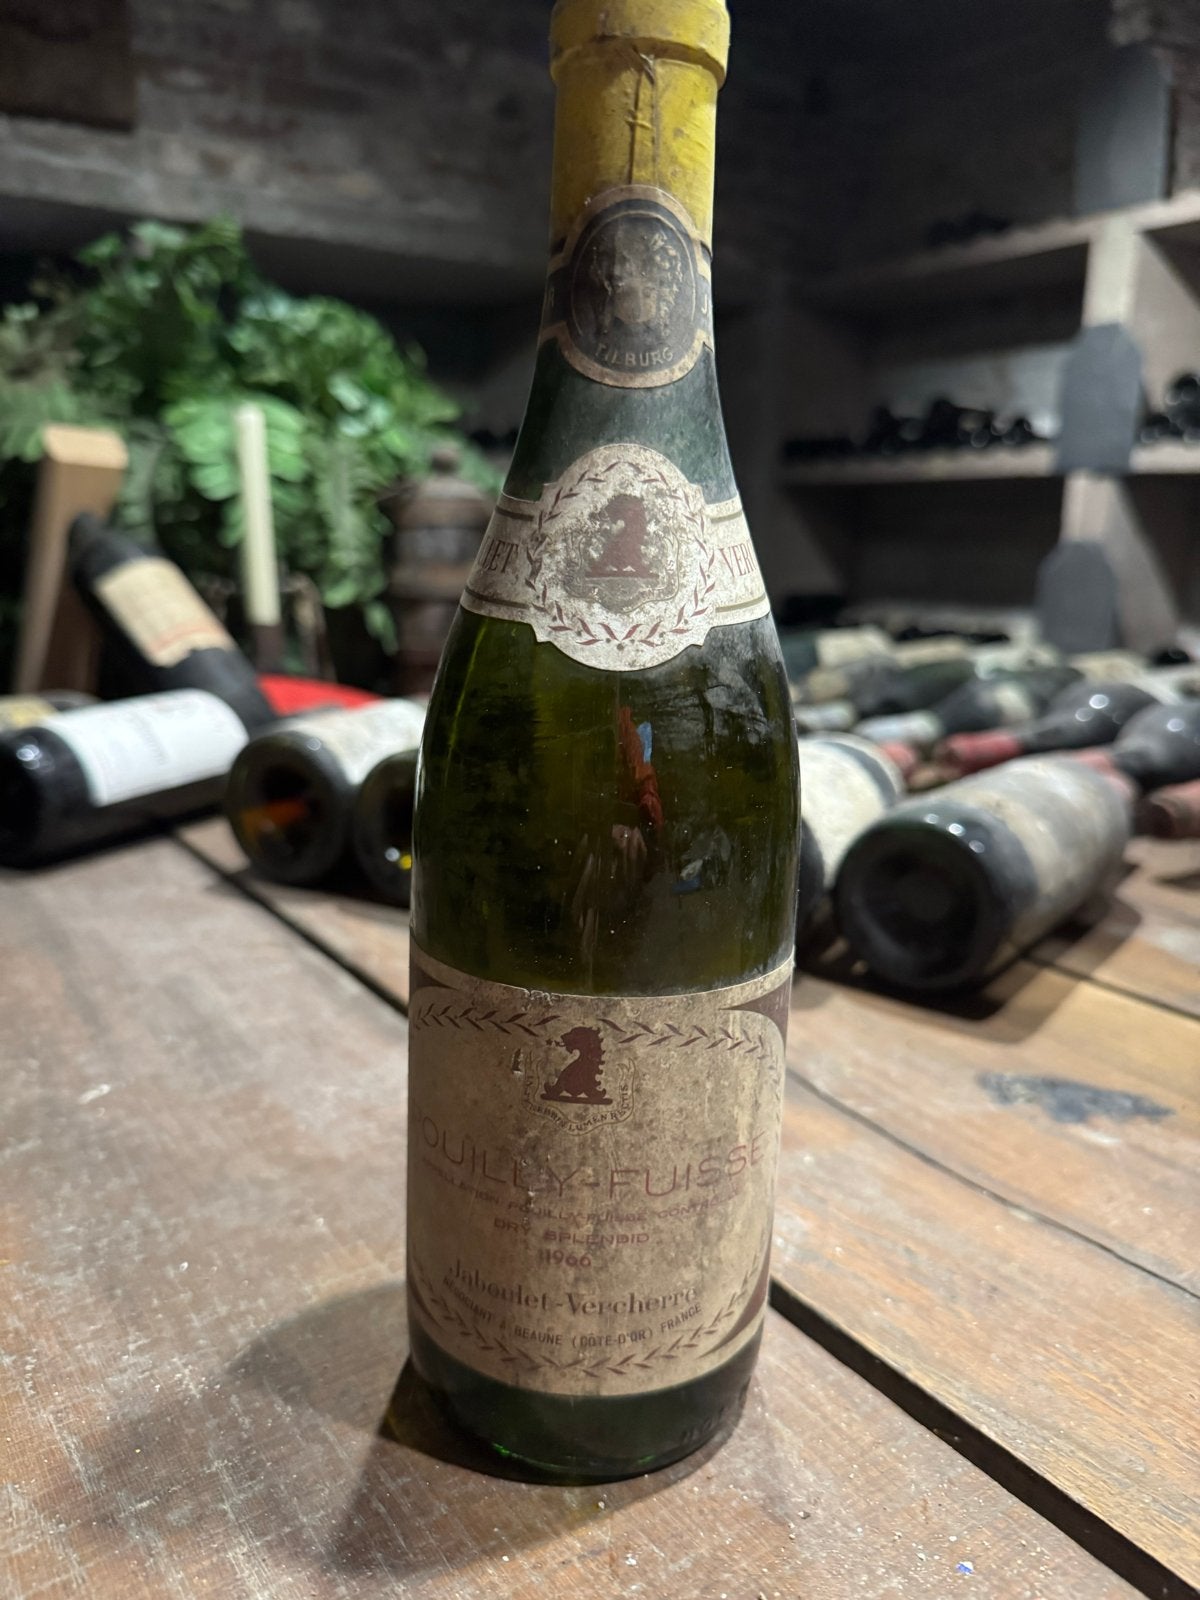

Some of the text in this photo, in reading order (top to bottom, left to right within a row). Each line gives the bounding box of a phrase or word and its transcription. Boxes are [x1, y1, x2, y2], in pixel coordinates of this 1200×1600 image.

[595, 343, 674, 367] TILBURG
[421, 1115, 766, 1199] OUILLY-FUISSE
[494, 1217, 650, 1247] DRY SPLENDID
[514, 1325, 563, 1345] BEAUNE
[660, 1304, 703, 1333] FRANCE
